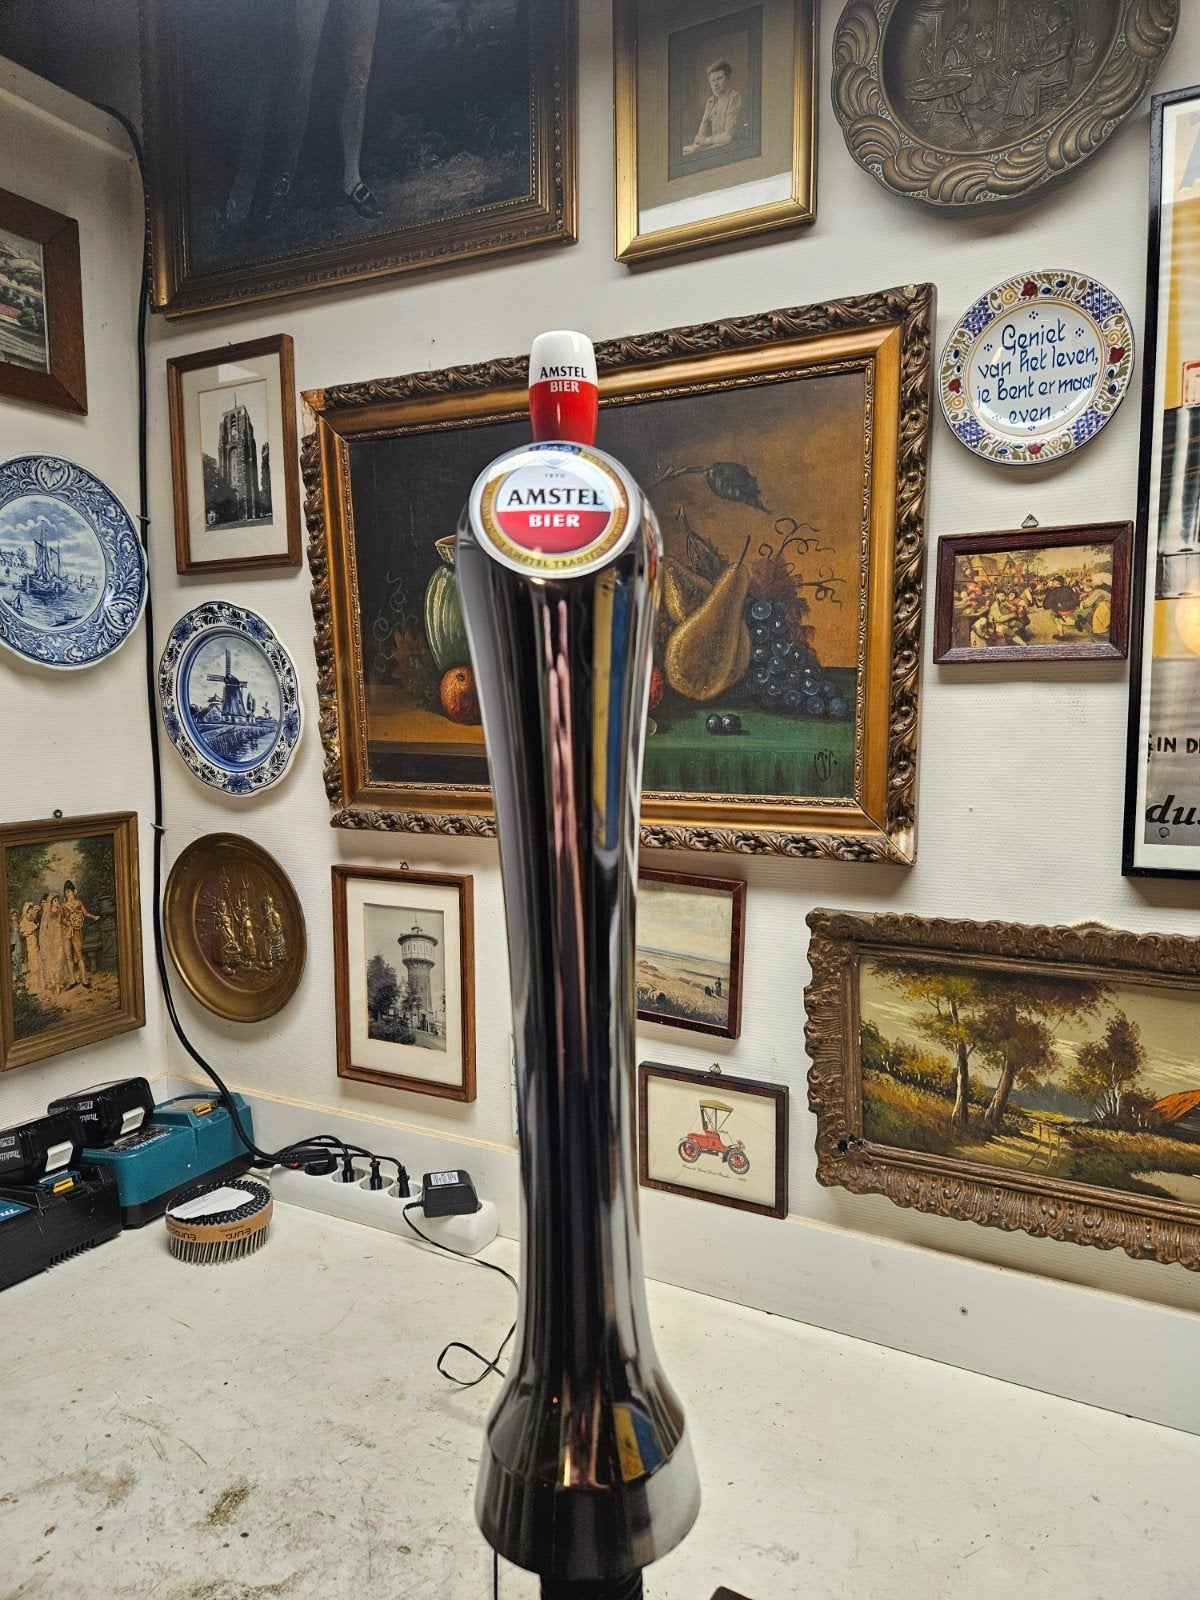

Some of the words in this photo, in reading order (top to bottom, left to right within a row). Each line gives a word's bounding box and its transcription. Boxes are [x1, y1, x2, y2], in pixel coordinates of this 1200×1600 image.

[1002, 318, 1066, 355] Geniet
[978, 360, 1011, 379] van
[1019, 348, 1048, 373] het
[1052, 345, 1098, 367] leven,
[540, 366, 587, 380] AMSTEL
[550, 381, 580, 393] BIER
[977, 386, 991, 408] je
[997, 376, 1034, 401] bent
[1038, 379, 1054, 396] er
[1058, 372, 1097, 394] maar
[507, 487, 604, 506] AMSTEL
[528, 514, 581, 527] BIER
[1157, 736, 1177, 753] IN
[1145, 794, 1200, 825] du
